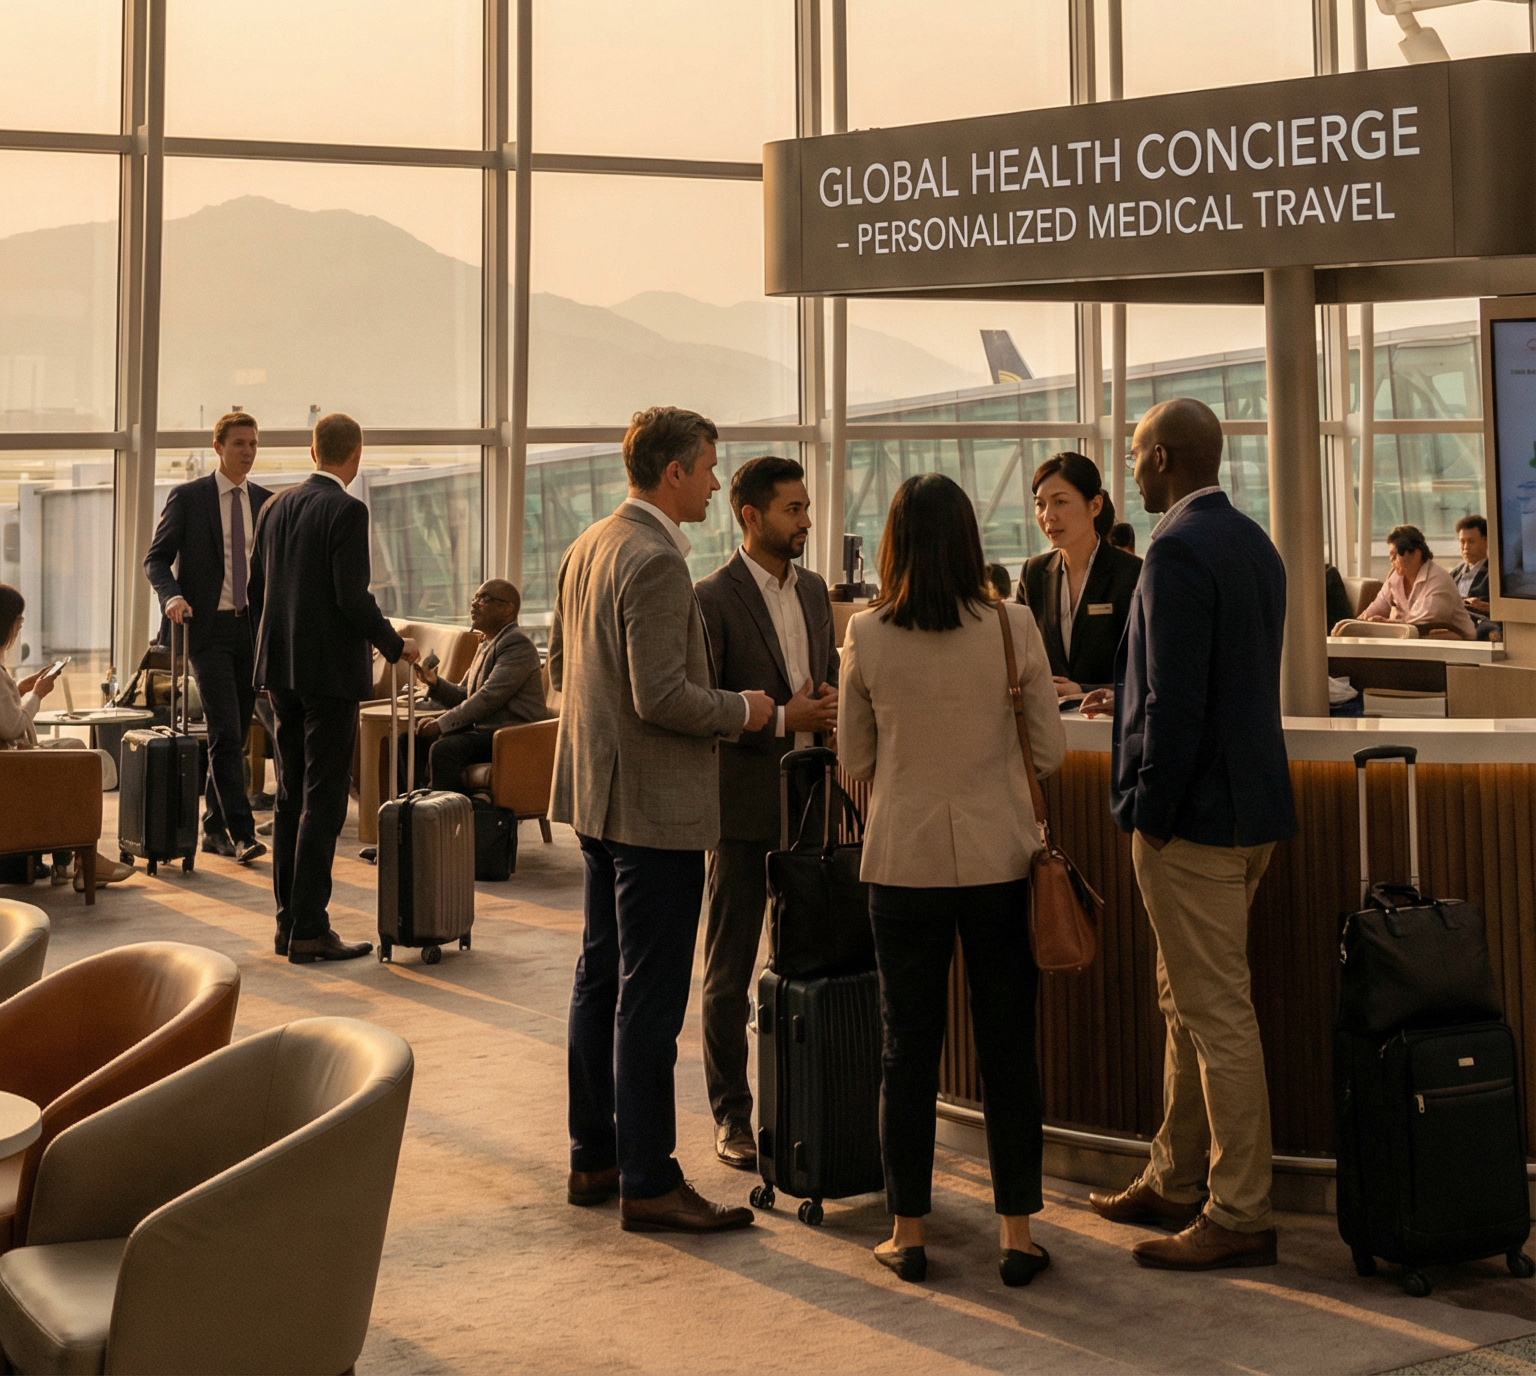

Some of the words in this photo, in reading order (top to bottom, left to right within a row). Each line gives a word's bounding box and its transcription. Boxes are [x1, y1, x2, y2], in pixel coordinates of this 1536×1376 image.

[819, 156, 960, 208] GLOBAL
[971, 138, 1121, 195] HEALTH
[1136, 106, 1420, 180] CONCIERGE
[858, 207, 1077, 256] PERSONALIZED
[1088, 194, 1244, 240] MEDICAL
[1252, 181, 1396, 228] TRAVEL
